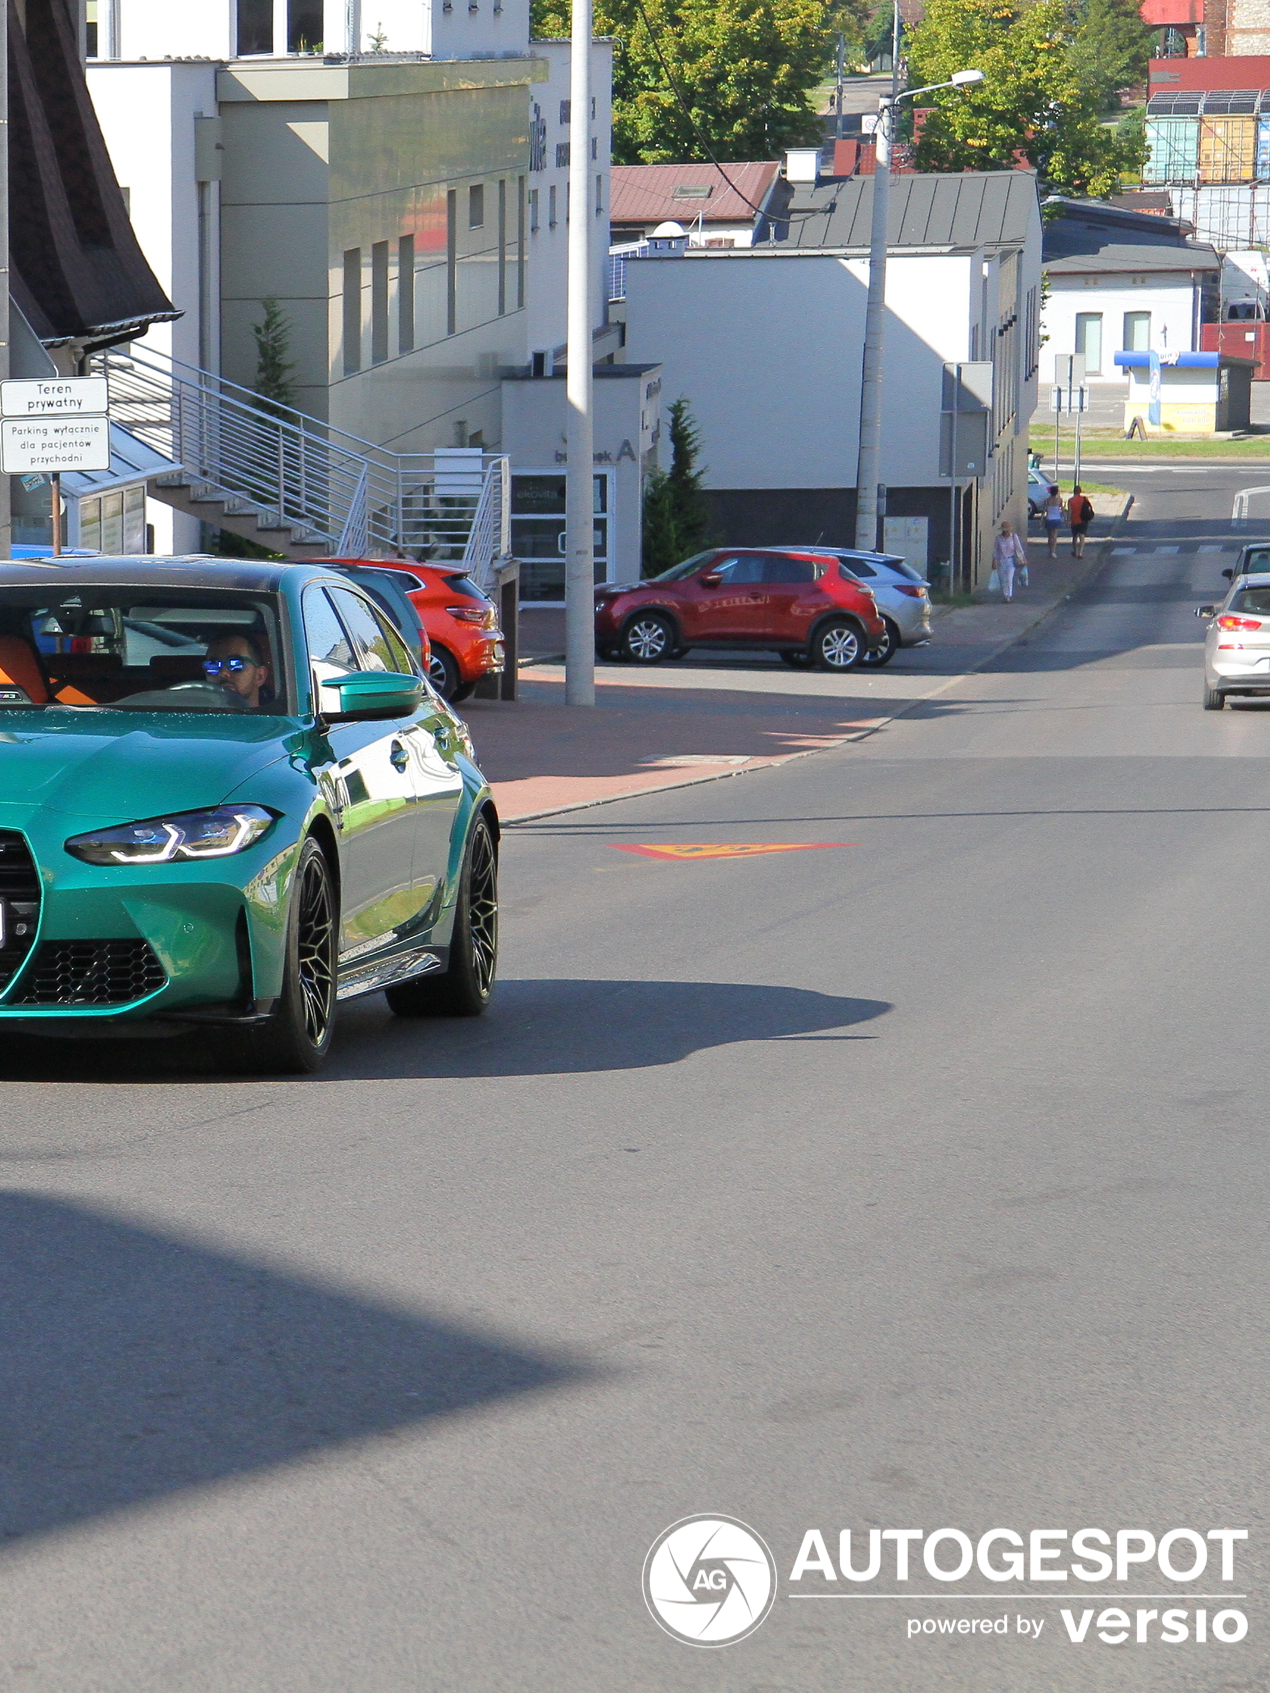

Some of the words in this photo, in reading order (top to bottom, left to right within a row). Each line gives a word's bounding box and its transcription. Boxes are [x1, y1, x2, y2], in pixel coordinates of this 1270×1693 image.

[37, 383, 72, 395] Teren
[28, 398, 83, 411] prywatny
[11, 426, 48, 436] Parking
[53, 424, 100, 436] wyłącznie
[20, 440, 35, 450] dla
[41, 439, 92, 451] pacjentów
[616, 439, 636, 461] A
[30, 453, 83, 465] przychodni
